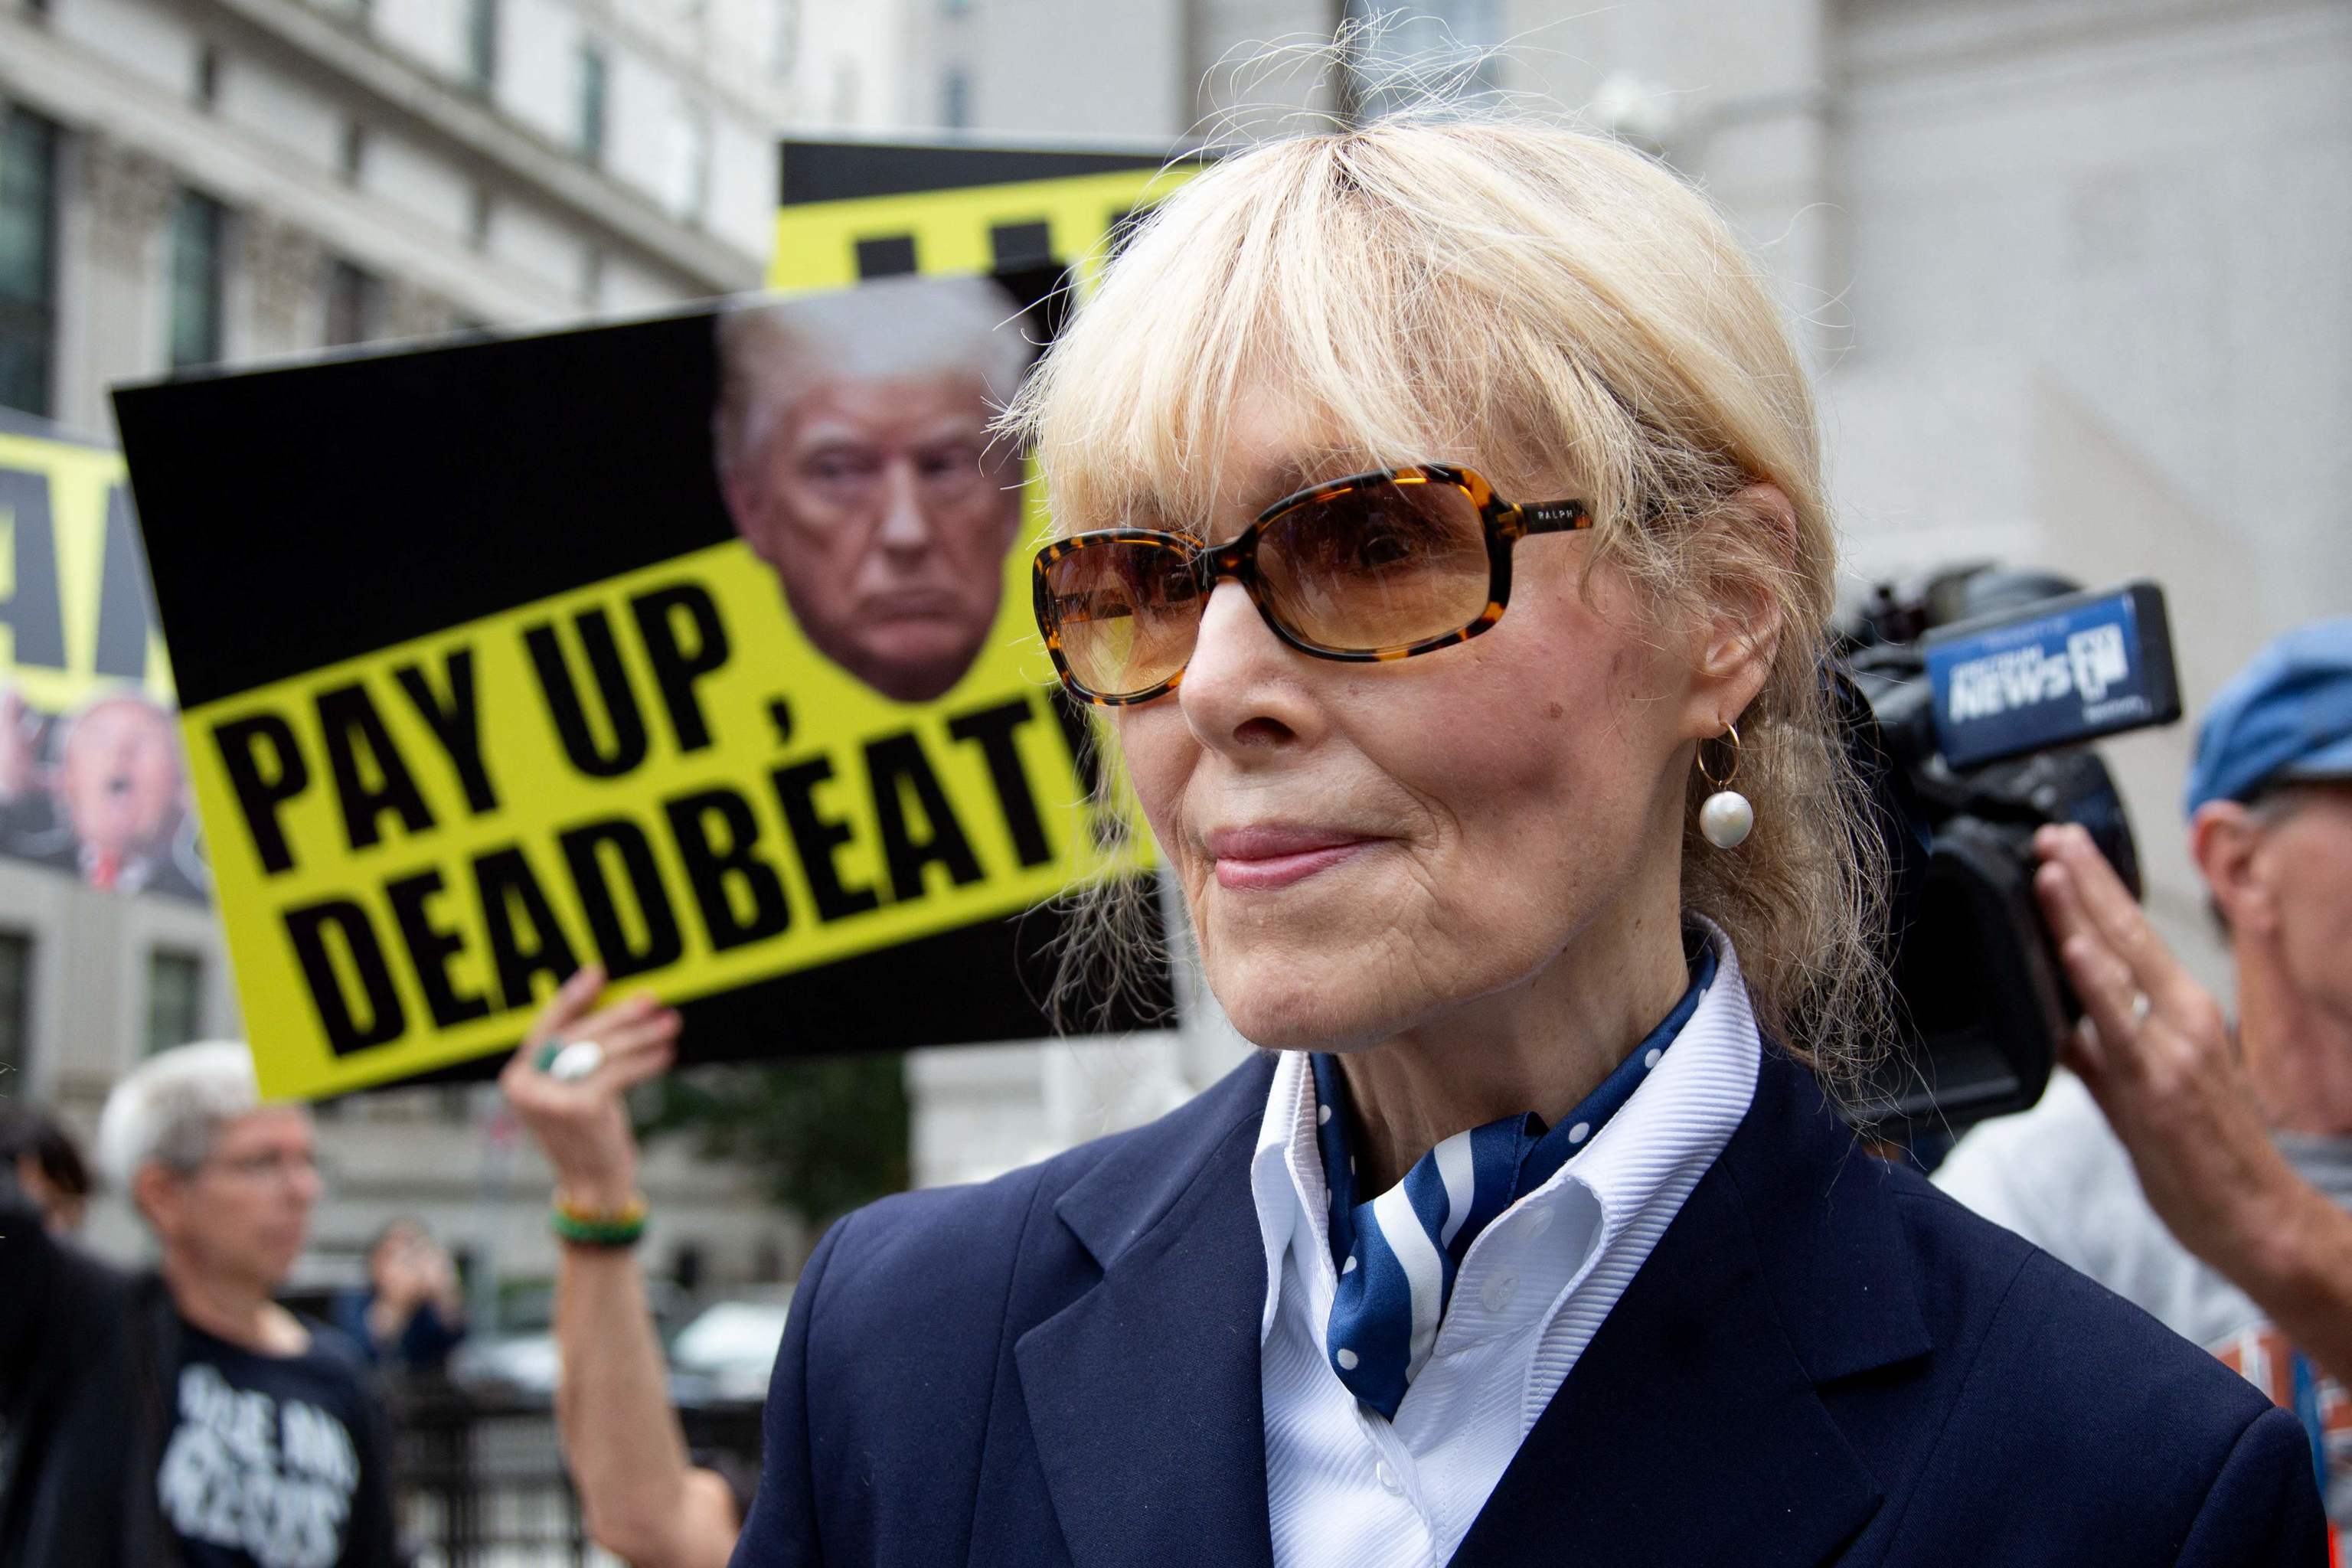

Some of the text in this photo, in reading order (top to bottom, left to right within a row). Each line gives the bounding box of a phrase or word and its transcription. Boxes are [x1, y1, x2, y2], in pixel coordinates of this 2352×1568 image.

[1537, 509, 1573, 520] RALPH
[213, 584, 794, 875] PAY UP,
